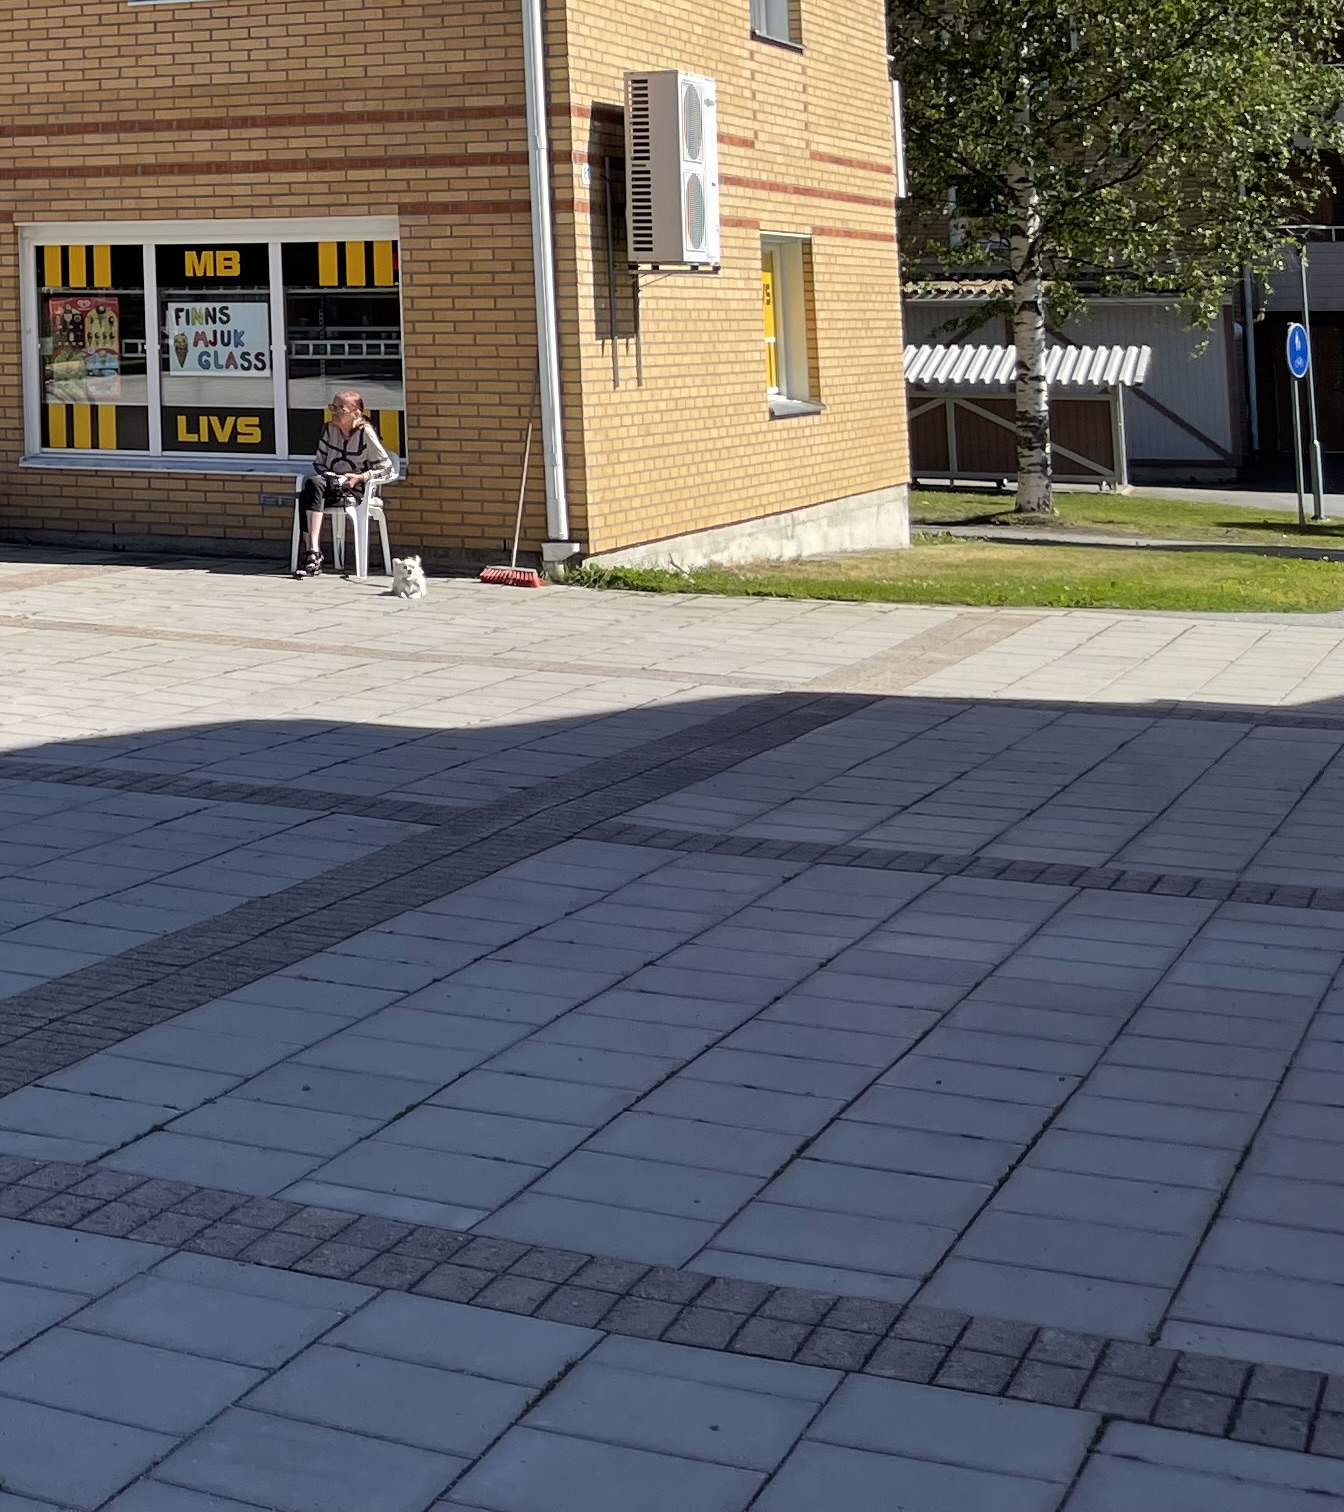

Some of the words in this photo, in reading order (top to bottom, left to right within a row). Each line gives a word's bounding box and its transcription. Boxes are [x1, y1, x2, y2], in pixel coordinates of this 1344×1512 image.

[184, 250, 241, 277] MB
[174, 306, 231, 326] FINNS
[193, 330, 245, 348] MJUK
[198, 351, 267, 372] GLASS
[177, 415, 262, 444] LIVS
